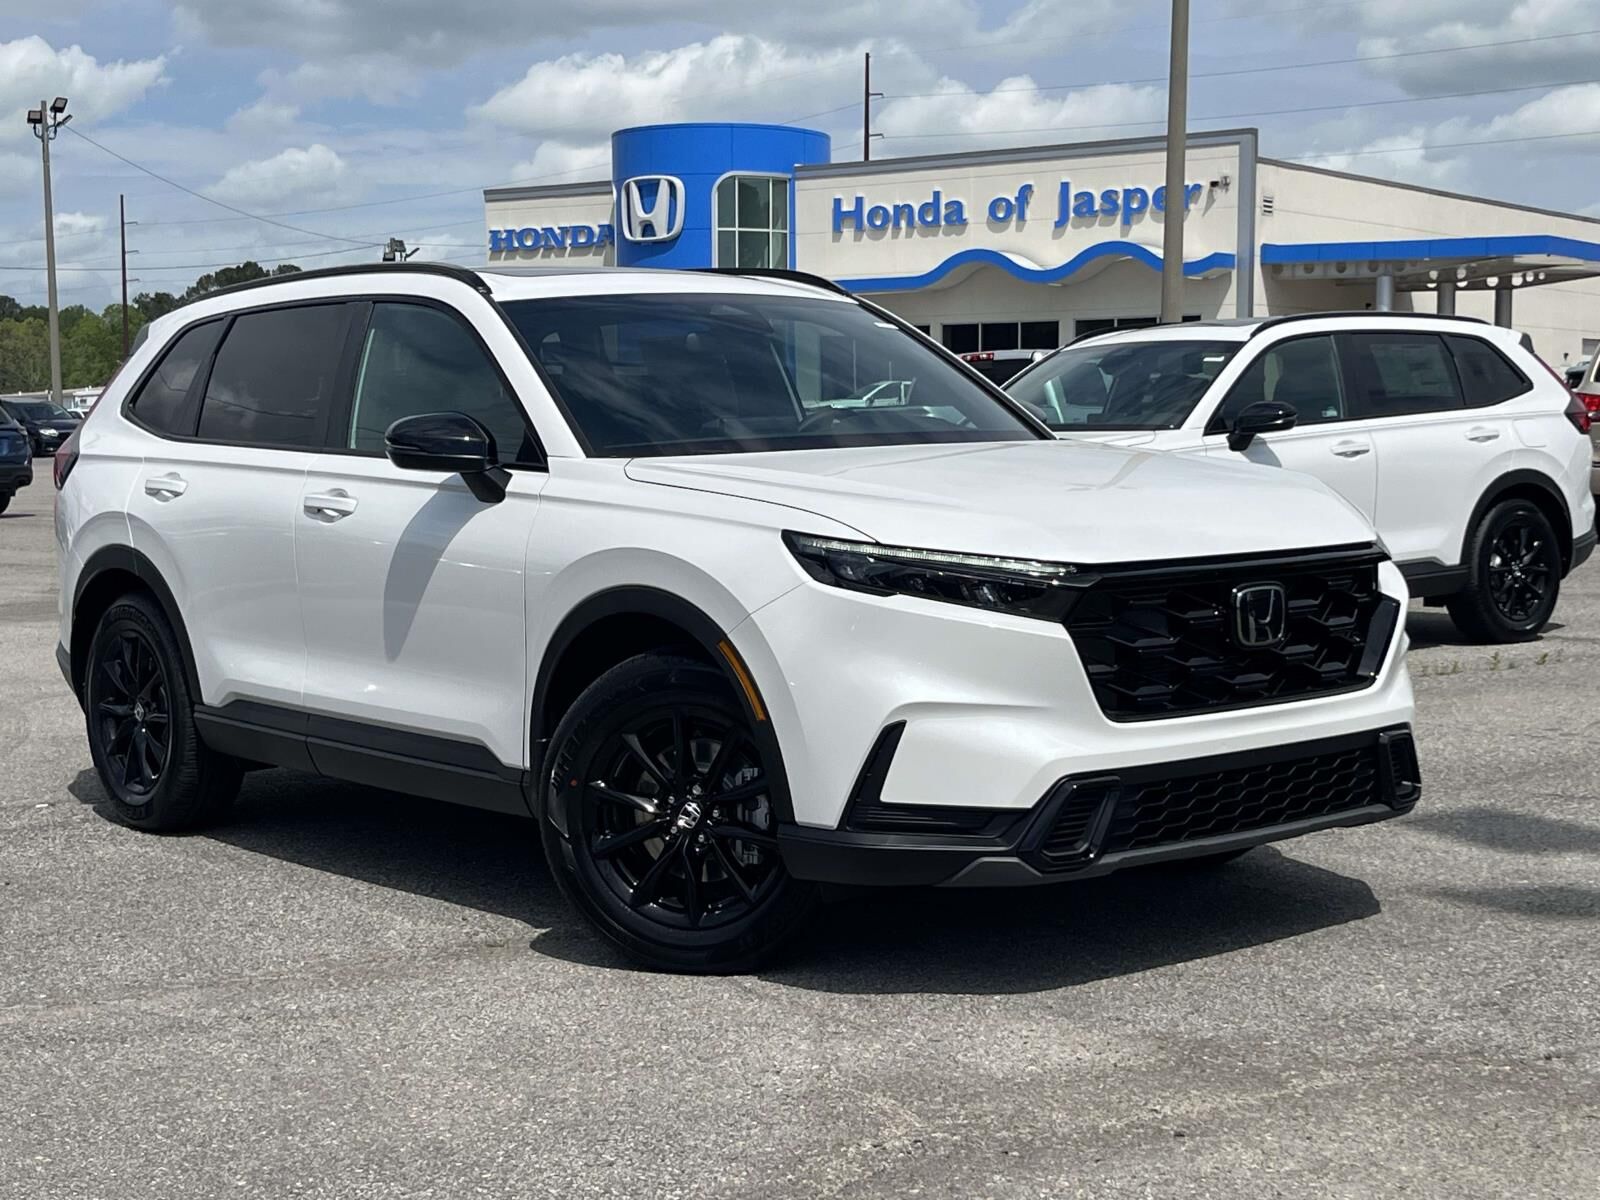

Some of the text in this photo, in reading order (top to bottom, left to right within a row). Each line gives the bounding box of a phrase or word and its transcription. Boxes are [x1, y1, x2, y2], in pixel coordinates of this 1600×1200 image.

[833, 191, 968, 233] Honda
[988, 184, 1033, 222] of
[489, 224, 615, 251] HONDA
